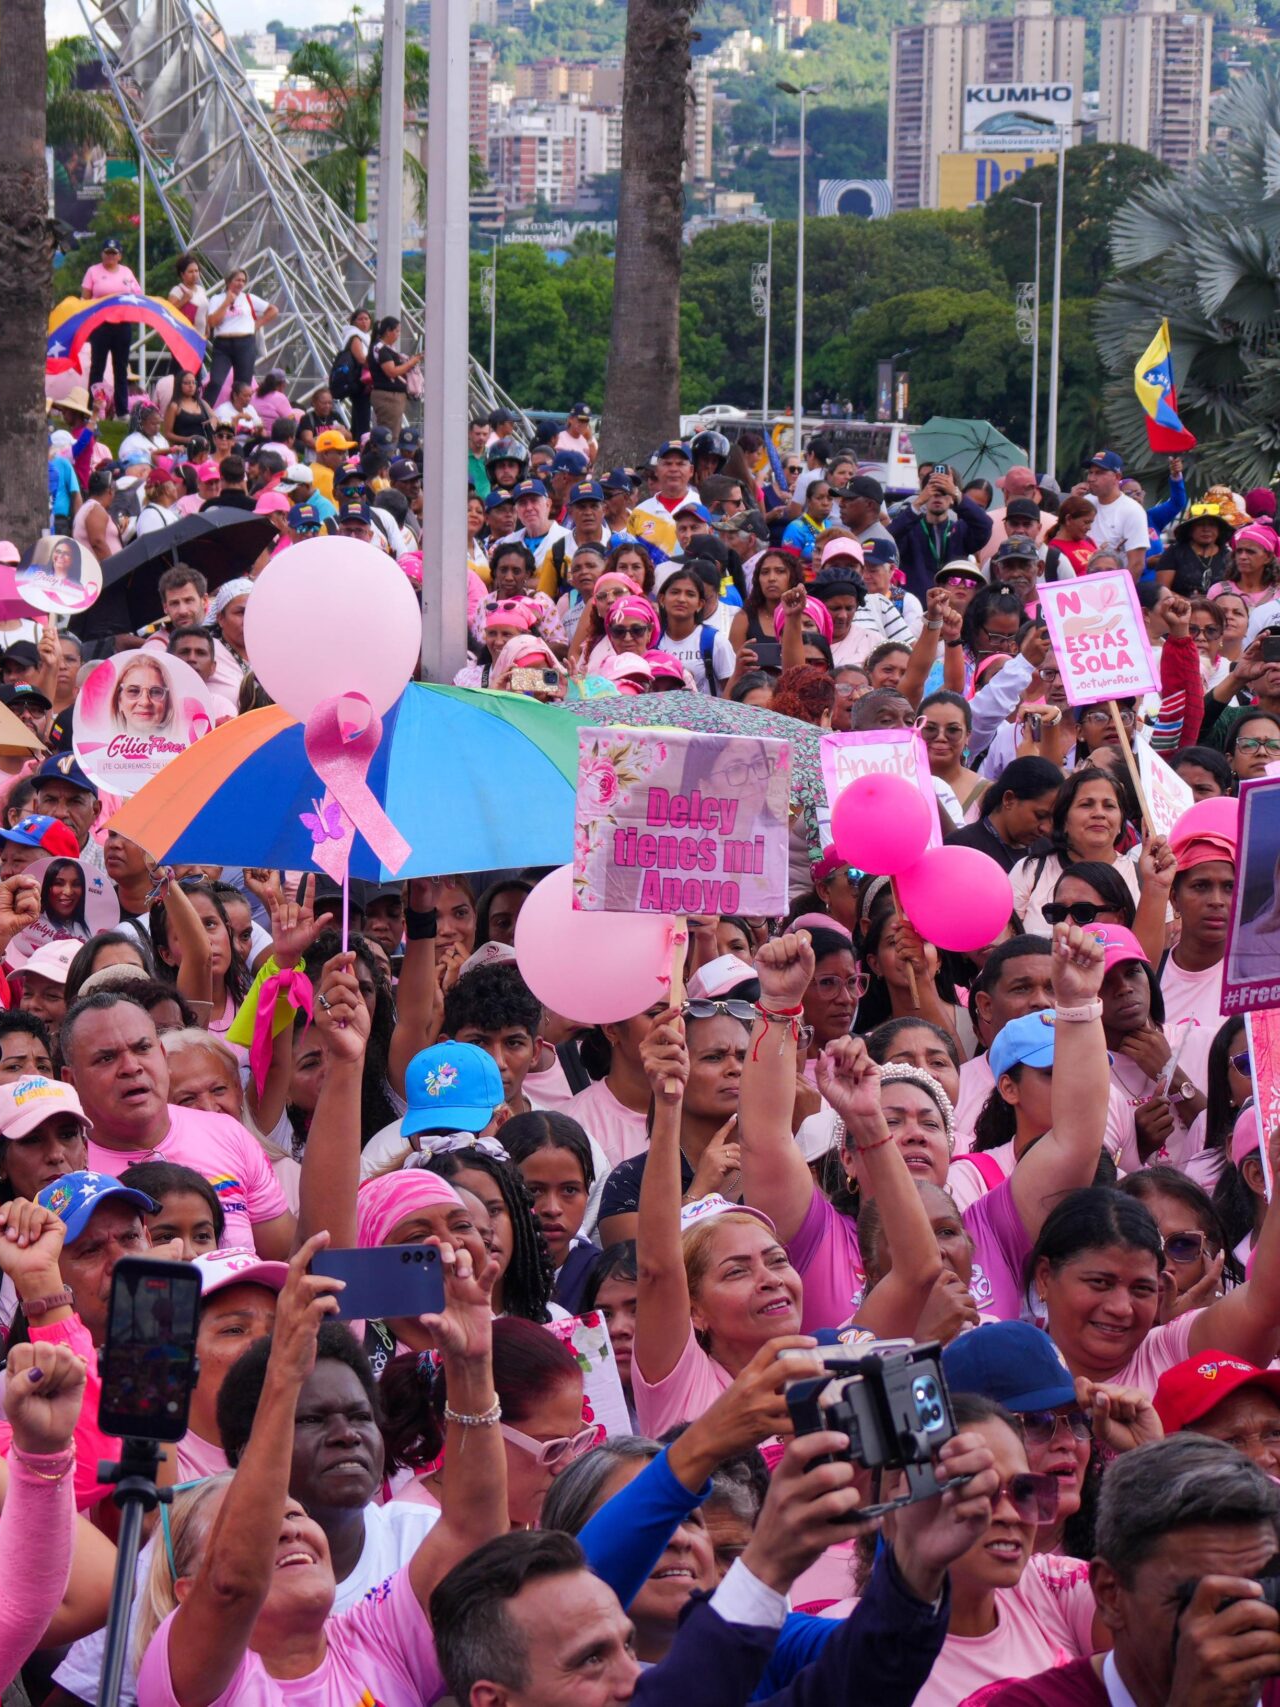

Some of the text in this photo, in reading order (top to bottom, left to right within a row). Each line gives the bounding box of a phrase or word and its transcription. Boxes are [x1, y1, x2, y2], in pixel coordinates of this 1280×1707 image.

[966, 87, 1072, 102] KUMHO
[1070, 650, 1135, 676] SOLA
[113, 762, 152, 771] QUEREMOS
[646, 786, 739, 836] Delcy
[613, 826, 765, 875] tienes mi
[639, 869, 741, 916] Apoyo
